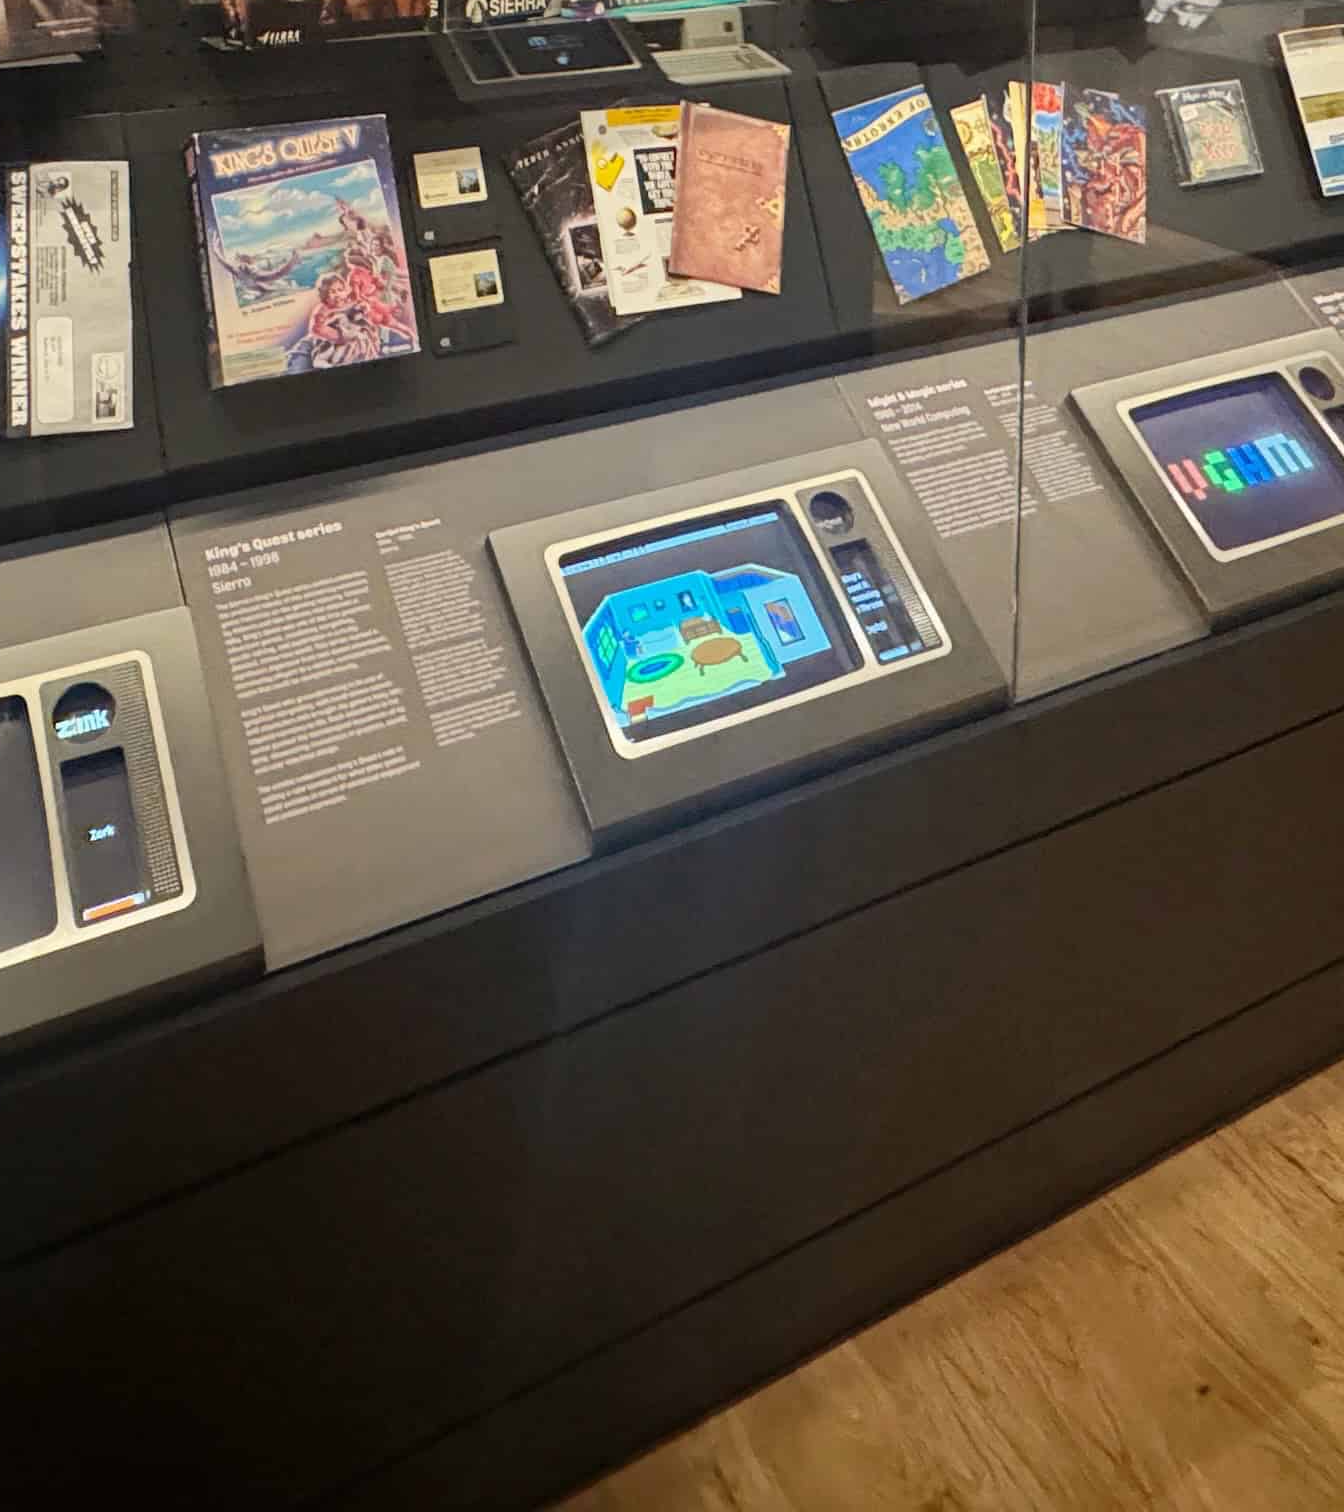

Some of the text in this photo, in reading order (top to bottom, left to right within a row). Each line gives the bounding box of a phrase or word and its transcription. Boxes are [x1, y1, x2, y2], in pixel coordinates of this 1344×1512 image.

[342, 124, 360, 146] V
[11, 170, 28, 427] SWEEPSTAKES WINNER
[205, 521, 343, 563] King's Quest series
[211, 576, 253, 595] Sierra
[88, 823, 116, 843] Zork
